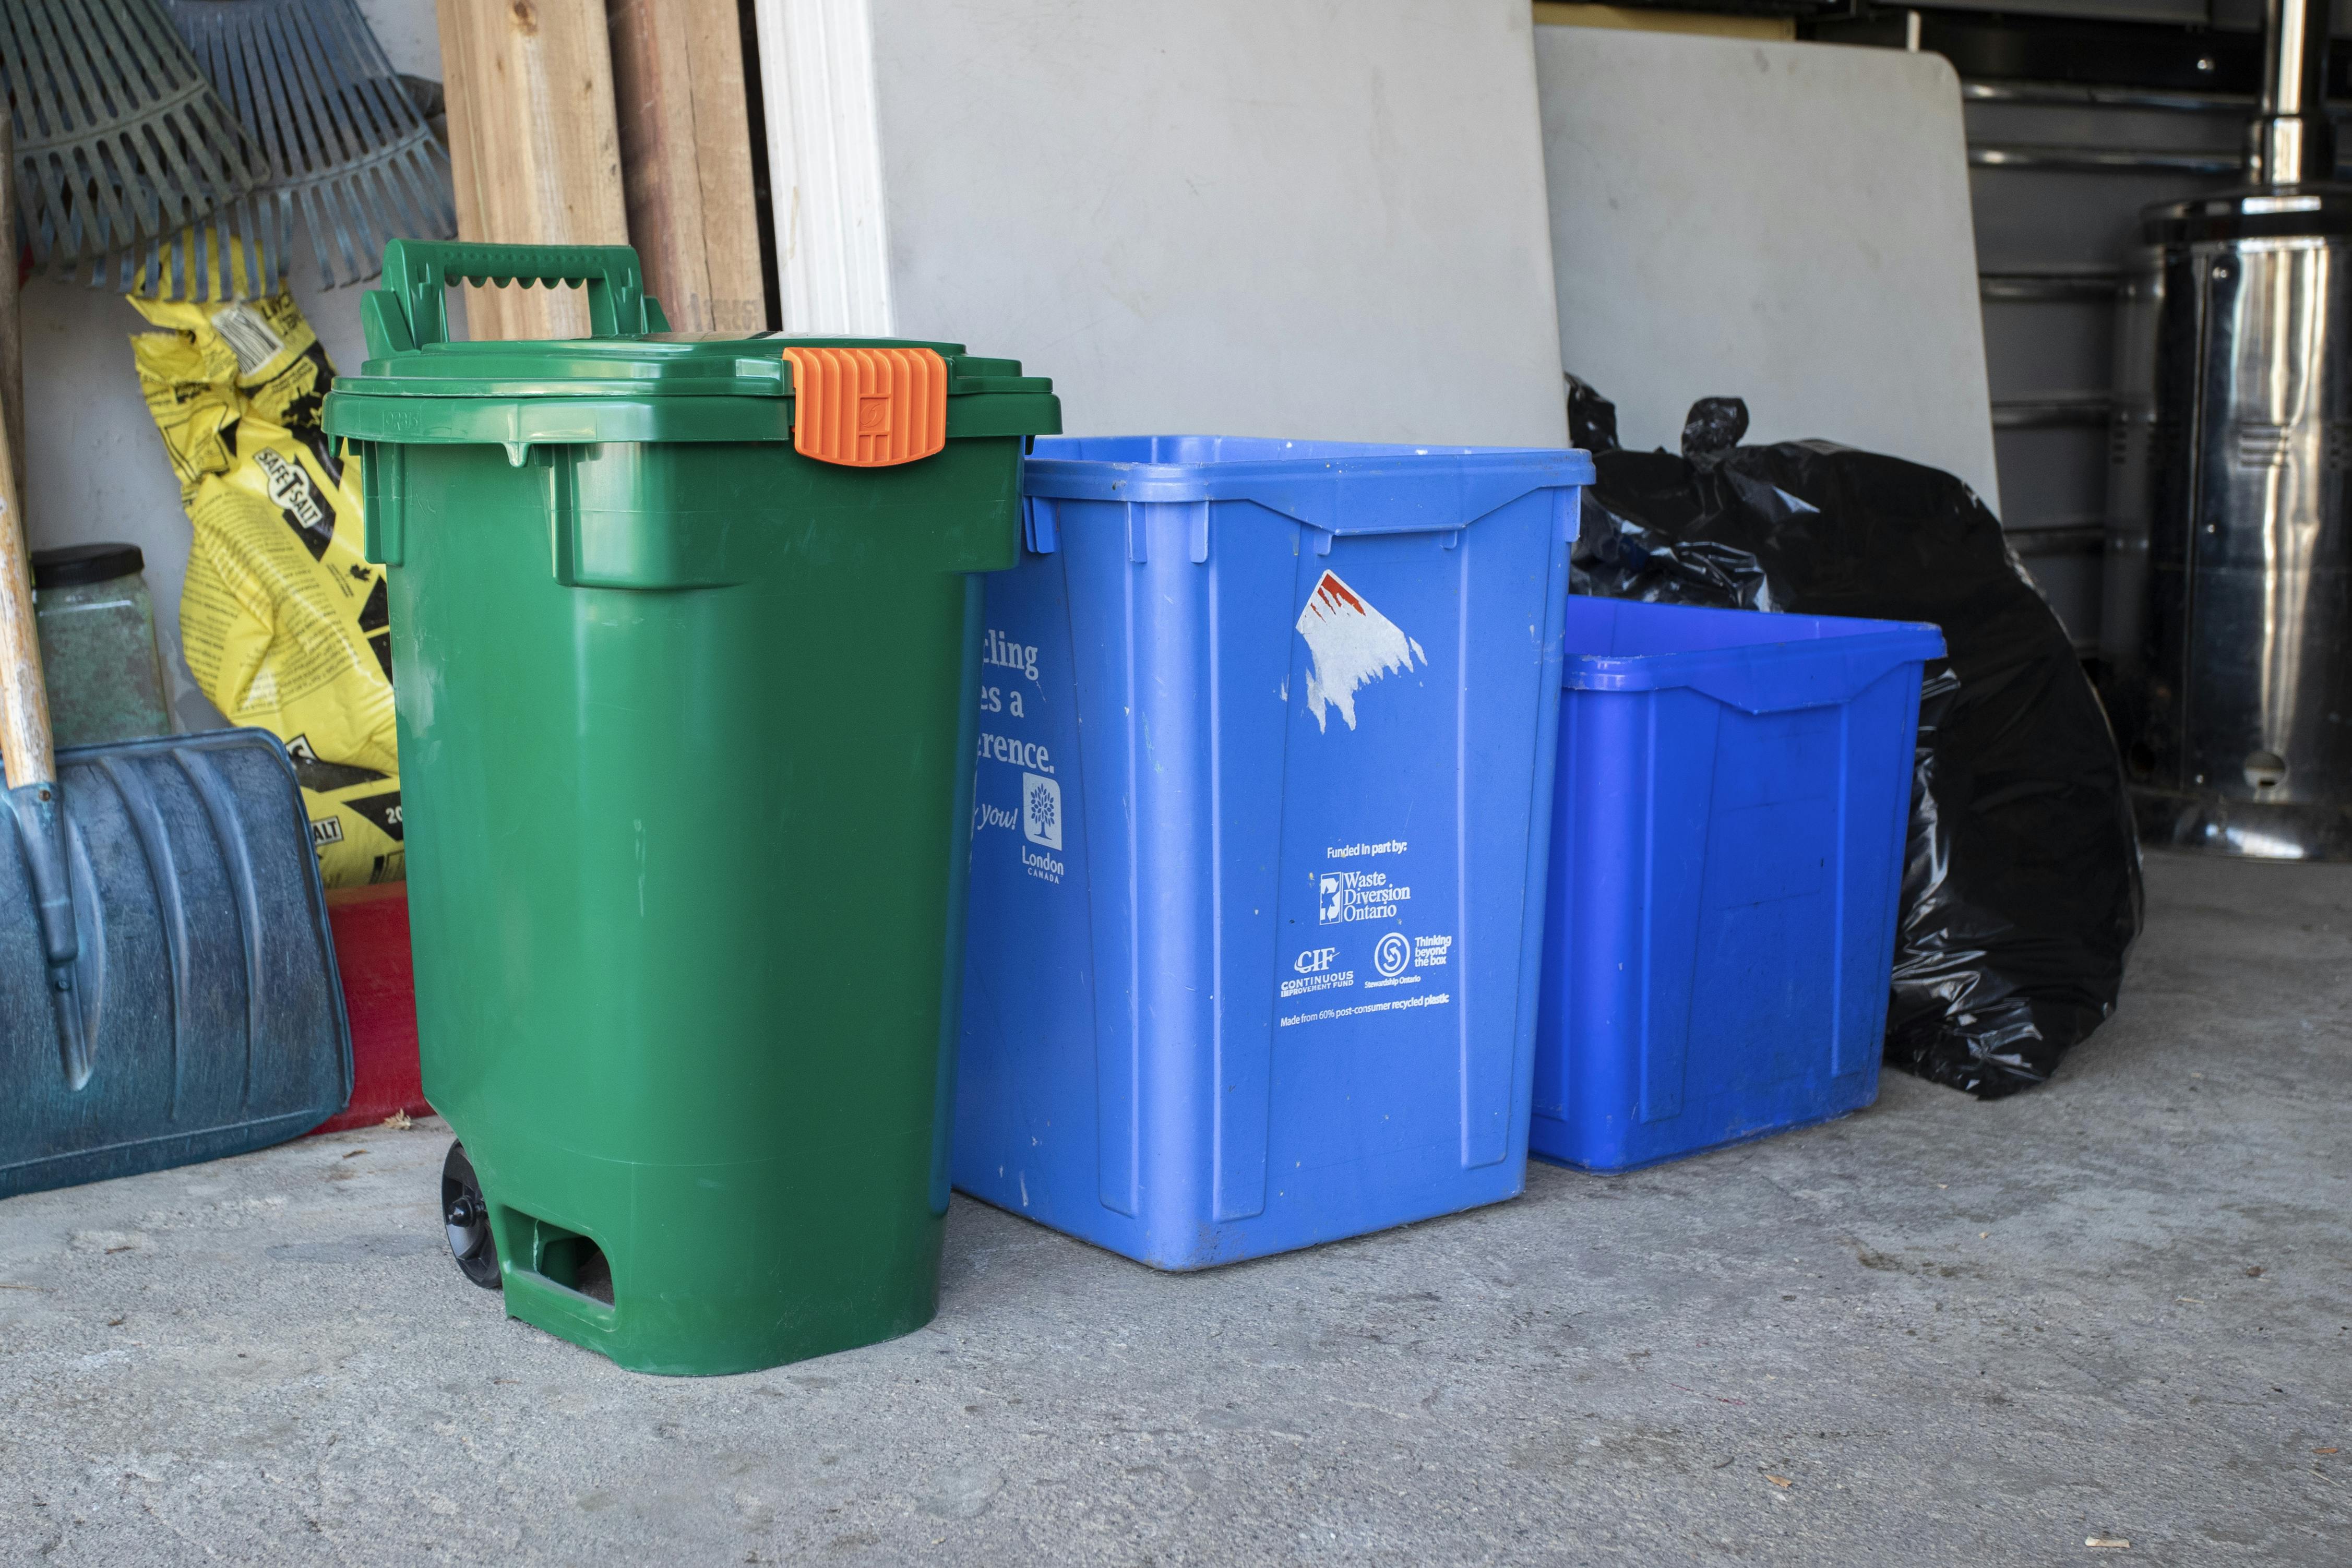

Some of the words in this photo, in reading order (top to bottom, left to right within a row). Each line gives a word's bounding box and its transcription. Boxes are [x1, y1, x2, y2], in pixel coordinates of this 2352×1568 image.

[1010, 690, 1024, 718] a
[978, 733, 1055, 774] rence.
[977, 804, 1018, 831] you!
[1327, 843, 1360, 859] Funded
[1362, 843, 1370, 855] in
[1371, 841, 1391, 856] part
[1392, 840, 1407, 854] by:
[1022, 845, 1064, 876] London
[1028, 867, 1059, 884] CANADA
[1344, 871, 1386, 889] Waste
[1344, 883, 1411, 906] Diversion
[1343, 901, 1397, 922] Ontario
[1415, 935, 1452, 947] Thinking
[1294, 947, 1338, 974] CIF
[1414, 957, 1429, 967] the
[1430, 955, 1447, 966] box
[1415, 945, 1447, 958] beyond
[1280, 983, 1331, 998] IMPROVEMENT
[1333, 979, 1354, 989] FUND
[1281, 971, 1354, 991] CONTINUOUS
[1364, 978, 1399, 989] Stewardship
[1399, 975, 1421, 985] Ontario
[1280, 1015, 1300, 1027] Made
[1301, 1013, 1318, 1023] from
[1319, 1009, 1335, 1020] 60%
[1335, 1002, 1391, 1019] post-consumer
[1392, 996, 1423, 1010] recycled
[1424, 992, 1450, 1007] plastic
